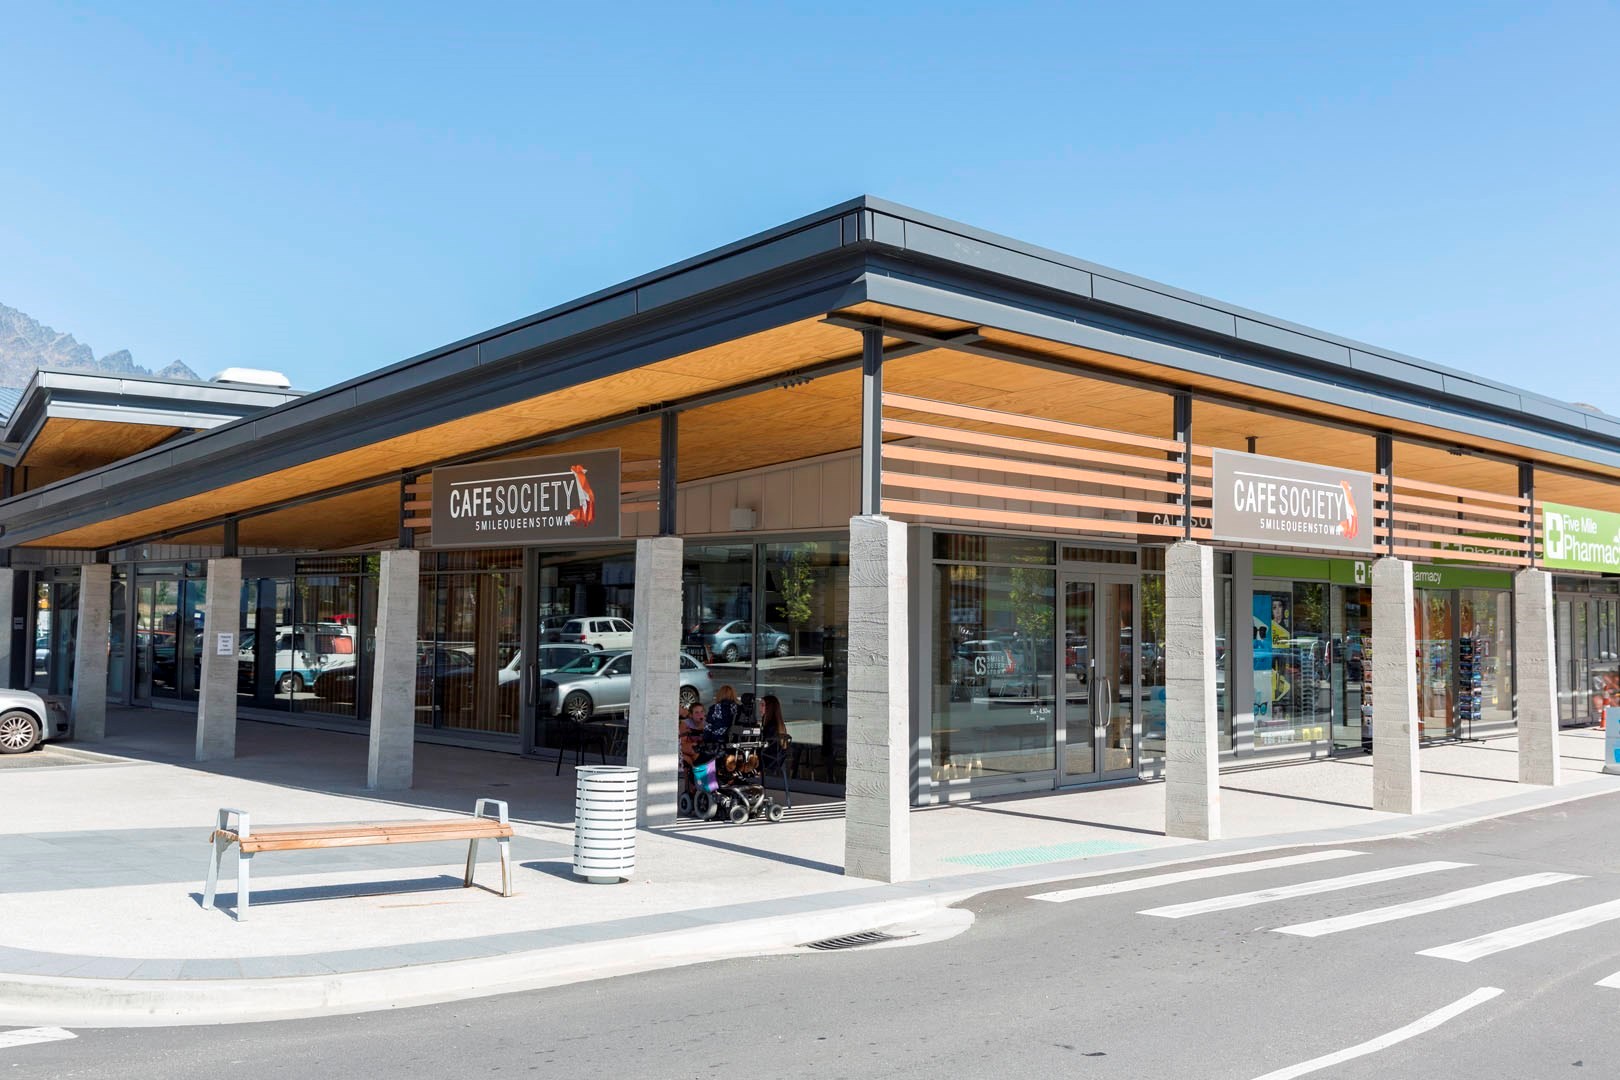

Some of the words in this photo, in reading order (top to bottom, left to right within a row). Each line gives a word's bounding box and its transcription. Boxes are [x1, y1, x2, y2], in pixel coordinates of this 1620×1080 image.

[450, 487, 493, 518] CAFE
[495, 480, 575, 515] SOCIETY
[1233, 479, 1277, 515] CAFE
[1279, 485, 1343, 521] SOCIETY
[1563, 514, 1580, 533] Five
[1581, 516, 1598, 534] Mile
[1564, 534, 1620, 565] Pharmac
[1412, 570, 1442, 584] armacy
[974, 656, 987, 675] CS
